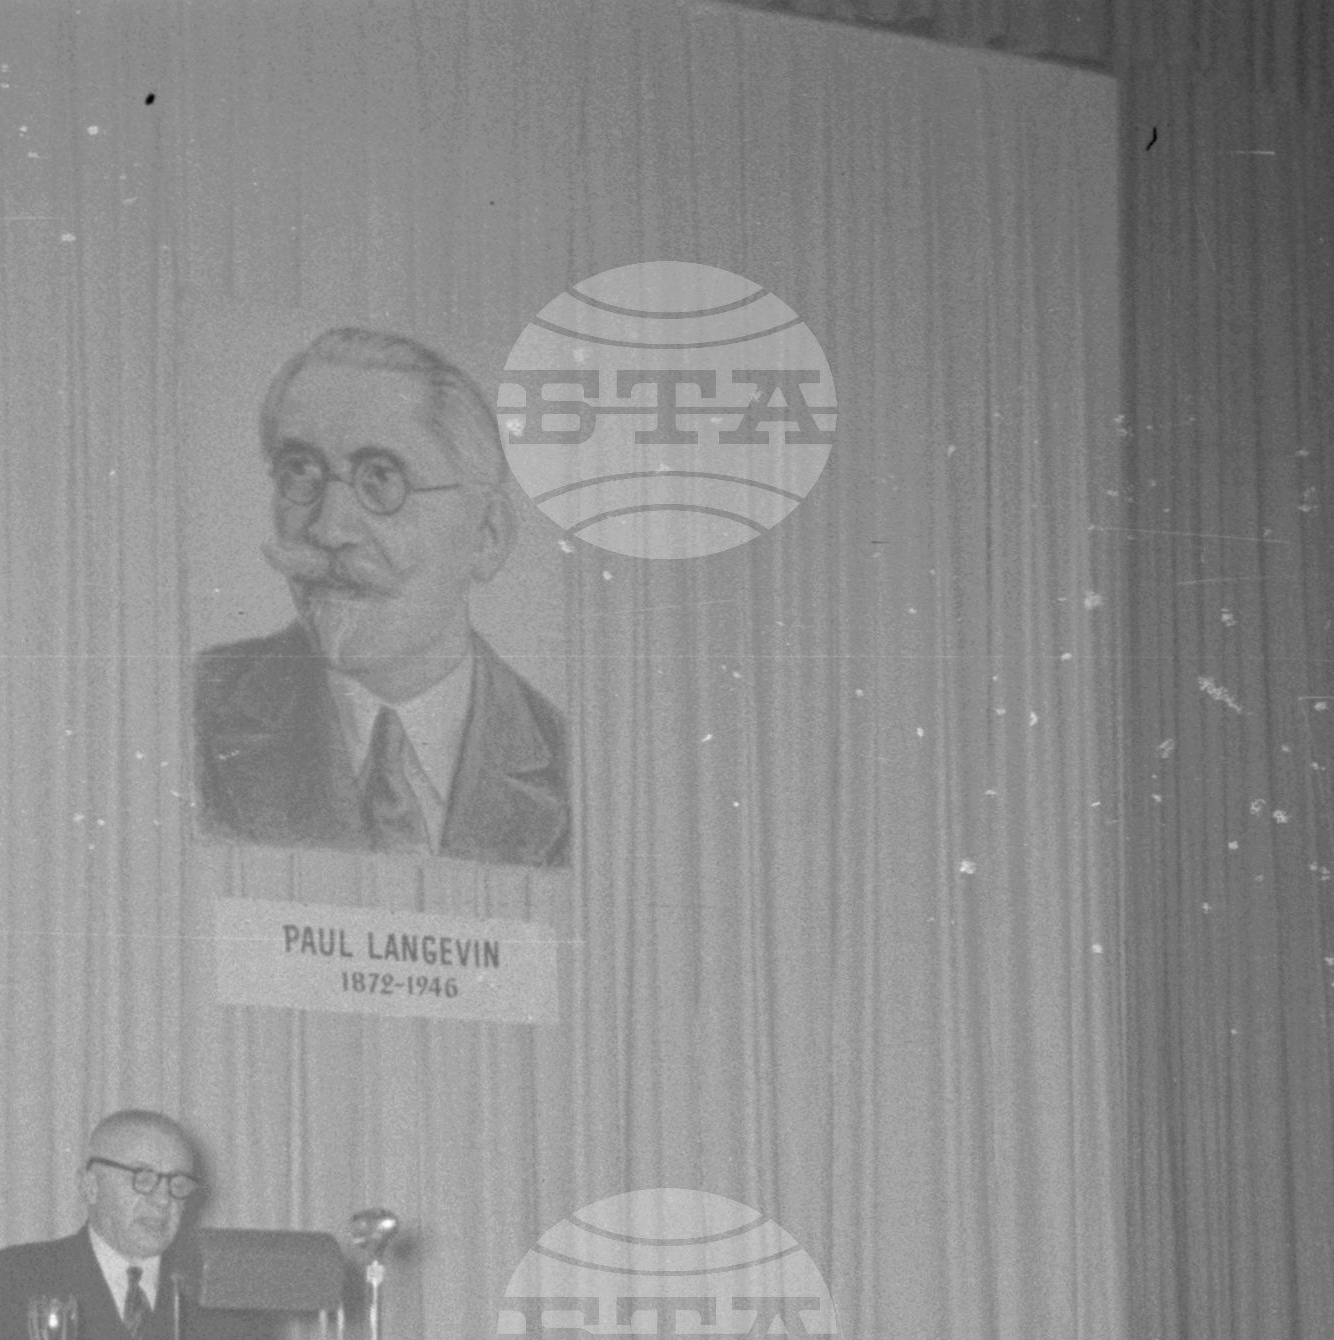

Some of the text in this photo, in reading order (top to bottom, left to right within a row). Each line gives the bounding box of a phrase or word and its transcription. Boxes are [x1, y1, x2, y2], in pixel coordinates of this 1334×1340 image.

[282, 924, 501, 969] PAUL LANGEVIN
[341, 971, 459, 999] 1872-1946
